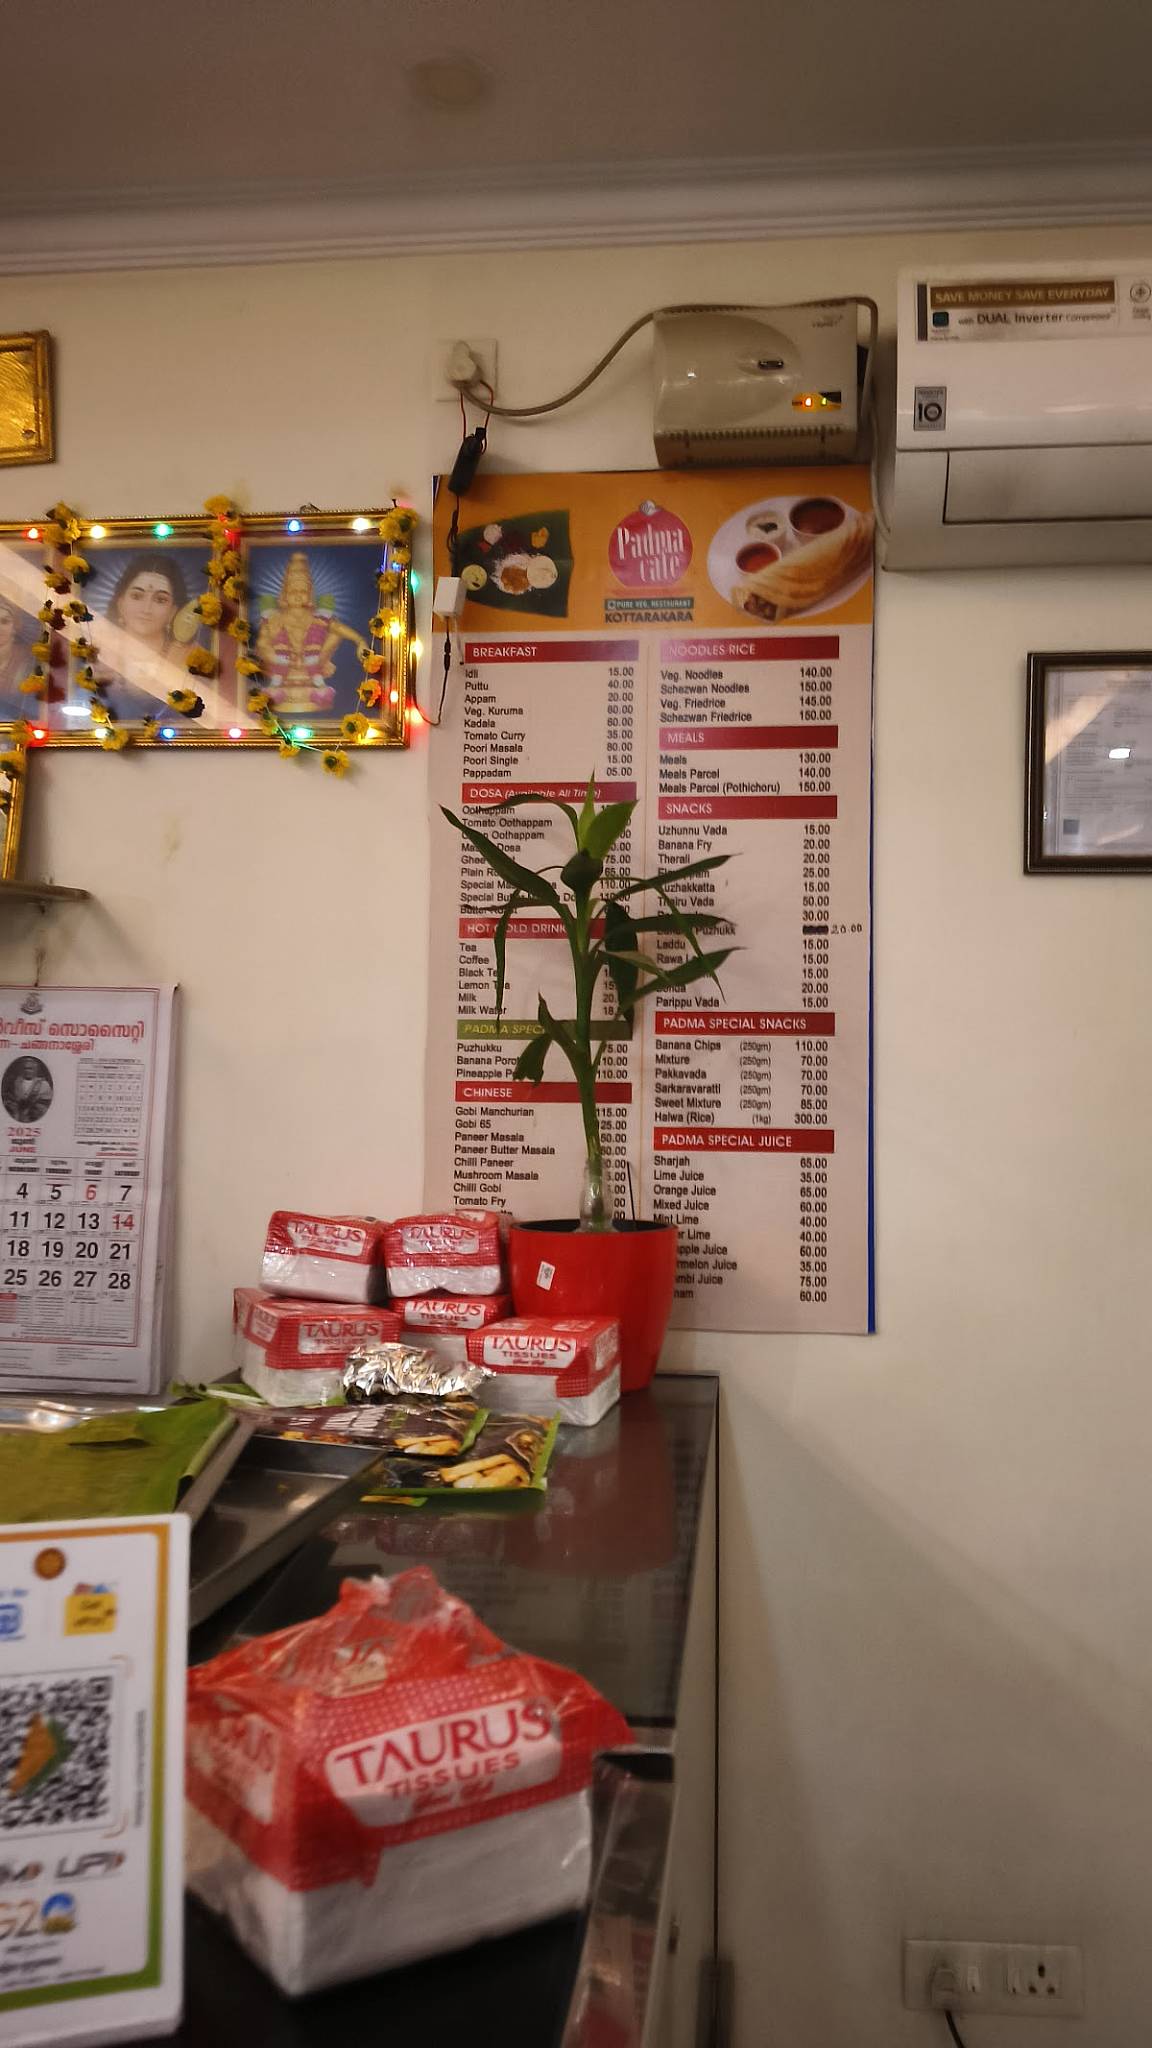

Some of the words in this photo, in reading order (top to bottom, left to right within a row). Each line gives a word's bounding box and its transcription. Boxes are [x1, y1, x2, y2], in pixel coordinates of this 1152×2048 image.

[936, 292, 965, 303] SAVE
[968, 290, 1012, 302] MONEY
[1015, 288, 1045, 301] SAVE
[1048, 286, 1109, 300] EVERYDAY
[977, 312, 1010, 324] DUAL
[1015, 312, 1063, 323] Inverter
[616, 525, 685, 561] Padma
[639, 555, 680, 582] cafe
[616, 599, 633, 608] PURE
[635, 599, 651, 608] VEG.
[651, 599, 691, 608] RESTAURANT
[605, 611, 694, 623] KOTTARAKARA
[473, 647, 537, 657] BREAKFAST
[670, 645, 725, 656] NOODLES
[729, 644, 755, 655] RICE
[466, 669, 478, 678] Idli
[661, 671, 681, 682] Veg.
[686, 670, 723, 679] Noodles
[800, 667, 832, 677] 140.00
[465, 682, 488, 690] Puttu
[660, 685, 707, 694] Schezwan
[712, 684, 749, 693] Noodles
[465, 695, 496, 704] Appam
[661, 699, 681, 709] Veg.
[685, 699, 725, 708] Friedrice
[465, 707, 485, 716] Veg.
[488, 707, 523, 715] Kuruma
[660, 713, 707, 722] Schezwan
[711, 713, 752, 722] Friedrice
[464, 719, 495, 727] Kadala
[464, 732, 497, 740] Tomato
[501, 732, 525, 742] Curry
[668, 733, 704, 743] MEALS
[464, 744, 487, 752] Poori
[491, 744, 523, 752] Masala
[464, 757, 487, 765] Poori
[490, 757, 518, 767] Single
[660, 755, 687, 764] Meals
[463, 769, 512, 779] Pappadam
[660, 769, 686, 779] Meals
[690, 769, 720, 778] Parcel
[470, 789, 503, 798] DOSA
[660, 784, 686, 793] Meals
[690, 784, 719, 793] Parcel
[723, 783, 780, 796] (Pothichoru)
[665, 803, 712, 814] SNACKS
[463, 819, 496, 827] Tomato
[500, 818, 552, 829] Oothappam
[492, 831, 545, 841] Oothappam
[658, 826, 699, 836] Uzhunnu
[703, 826, 727, 835] Vada
[658, 841, 694, 850] Banana
[697, 841, 712, 852] Fry
[803, 840, 830, 849] 20.00
[658, 854, 690, 864] Therali
[803, 854, 830, 863] 20.00
[461, 868, 483, 876] Plain
[461, 881, 494, 889] Special
[460, 893, 493, 902] Special
[691, 897, 714, 906] Vada
[467, 924, 490, 933] HOT
[460, 944, 476, 952] Tea
[657, 940, 685, 949] Laddu
[459, 956, 489, 965] Coffee
[657, 954, 685, 964] Rawa
[459, 968, 484, 977] Black
[459, 981, 490, 990] Lemon
[802, 984, 828, 993] 20.00
[458, 993, 476, 1002] Milk
[657, 998, 692, 1009] Parippu
[695, 998, 719, 1008] Vada
[458, 1006, 476, 1015] Milk
[664, 1019, 705, 1029] PADMA
[710, 1019, 756, 1029] SPECIAL
[760, 1019, 807, 1029] SNACKS
[457, 1044, 502, 1054] Puzhukku
[656, 1040, 691, 1050] Banana
[694, 1040, 721, 1051] Chips
[795, 1041, 828, 1051] 110.00
[457, 1057, 492, 1065] Banana
[656, 1055, 690, 1065] Mixture
[801, 1056, 828, 1066] 70.00
[457, 1069, 503, 1079] Pineapple
[655, 1069, 706, 1079] Pakkavada
[801, 1071, 828, 1081] 70.00
[464, 1088, 512, 1097] CHINESE
[801, 1085, 828, 1095] 70.00
[655, 1098, 685, 1108] Sweet
[687, 1098, 722, 1108] Mixture
[456, 1107, 477, 1116] Gobi
[480, 1107, 534, 1116] Manchurian
[655, 1112, 682, 1122] Halwa
[686, 1113, 715, 1124] (Rice)
[794, 1114, 828, 1125] 300.00
[456, 1120, 477, 1129] Gobi
[480, 1120, 491, 1128] 65
[7, 1127, 41, 1136] 2025
[455, 1133, 488, 1141] Paneer
[491, 1133, 524, 1142] Masala
[662, 1135, 704, 1145] PADMA
[708, 1136, 755, 1146] SPECIAL
[758, 1136, 792, 1147] JUICE
[455, 1145, 488, 1154] Paneer
[491, 1146, 518, 1155] Butter
[521, 1146, 555, 1155] Masala
[454, 1158, 477, 1167] Chilli
[480, 1158, 514, 1167] Paneer
[654, 1156, 690, 1168] Sharjah
[454, 1171, 503, 1180] Mushroom
[506, 1171, 539, 1180] Masala
[654, 1171, 676, 1181] Lime
[679, 1171, 704, 1182] Juice
[16, 1183, 28, 1199] 4
[51, 1185, 61, 1200] 5
[86, 1184, 96, 1200] 6
[120, 1186, 132, 1201] 7
[454, 1183, 476, 1192] Chilli
[480, 1184, 501, 1192] Gobi
[654, 1186, 688, 1197] Orange
[691, 1186, 716, 1196] Juice
[454, 1196, 488, 1205] Tomato
[491, 1197, 506, 1207] Fry
[654, 1200, 681, 1210] Mixed
[684, 1201, 709, 1211] Juice
[10, 1211, 29, 1227] 11
[43, 1213, 65, 1229] 12
[78, 1213, 100, 1229] 13
[112, 1214, 134, 1230] 14
[676, 1215, 699, 1225] Lime
[291, 1220, 362, 1242] TAURUS
[687, 1230, 710, 1240] Lime
[7, 1240, 29, 1257] 18
[42, 1242, 64, 1258] 19
[76, 1242, 98, 1259] 20
[110, 1244, 130, 1260] 21
[702, 1245, 728, 1255] Juice
[4, 1269, 27, 1285] 25
[38, 1270, 62, 1287] 26
[73, 1271, 97, 1287] 27
[108, 1273, 130, 1289] 28
[420, 1313, 469, 1322] TISSUES
[304, 1322, 380, 1338] TAURUS
[492, 1336, 571, 1352] TAURUS
[500, 1350, 557, 1360] TISSUES
[334, 1703, 553, 1786] TAURUS
[387, 1752, 520, 1800] TISSUES
